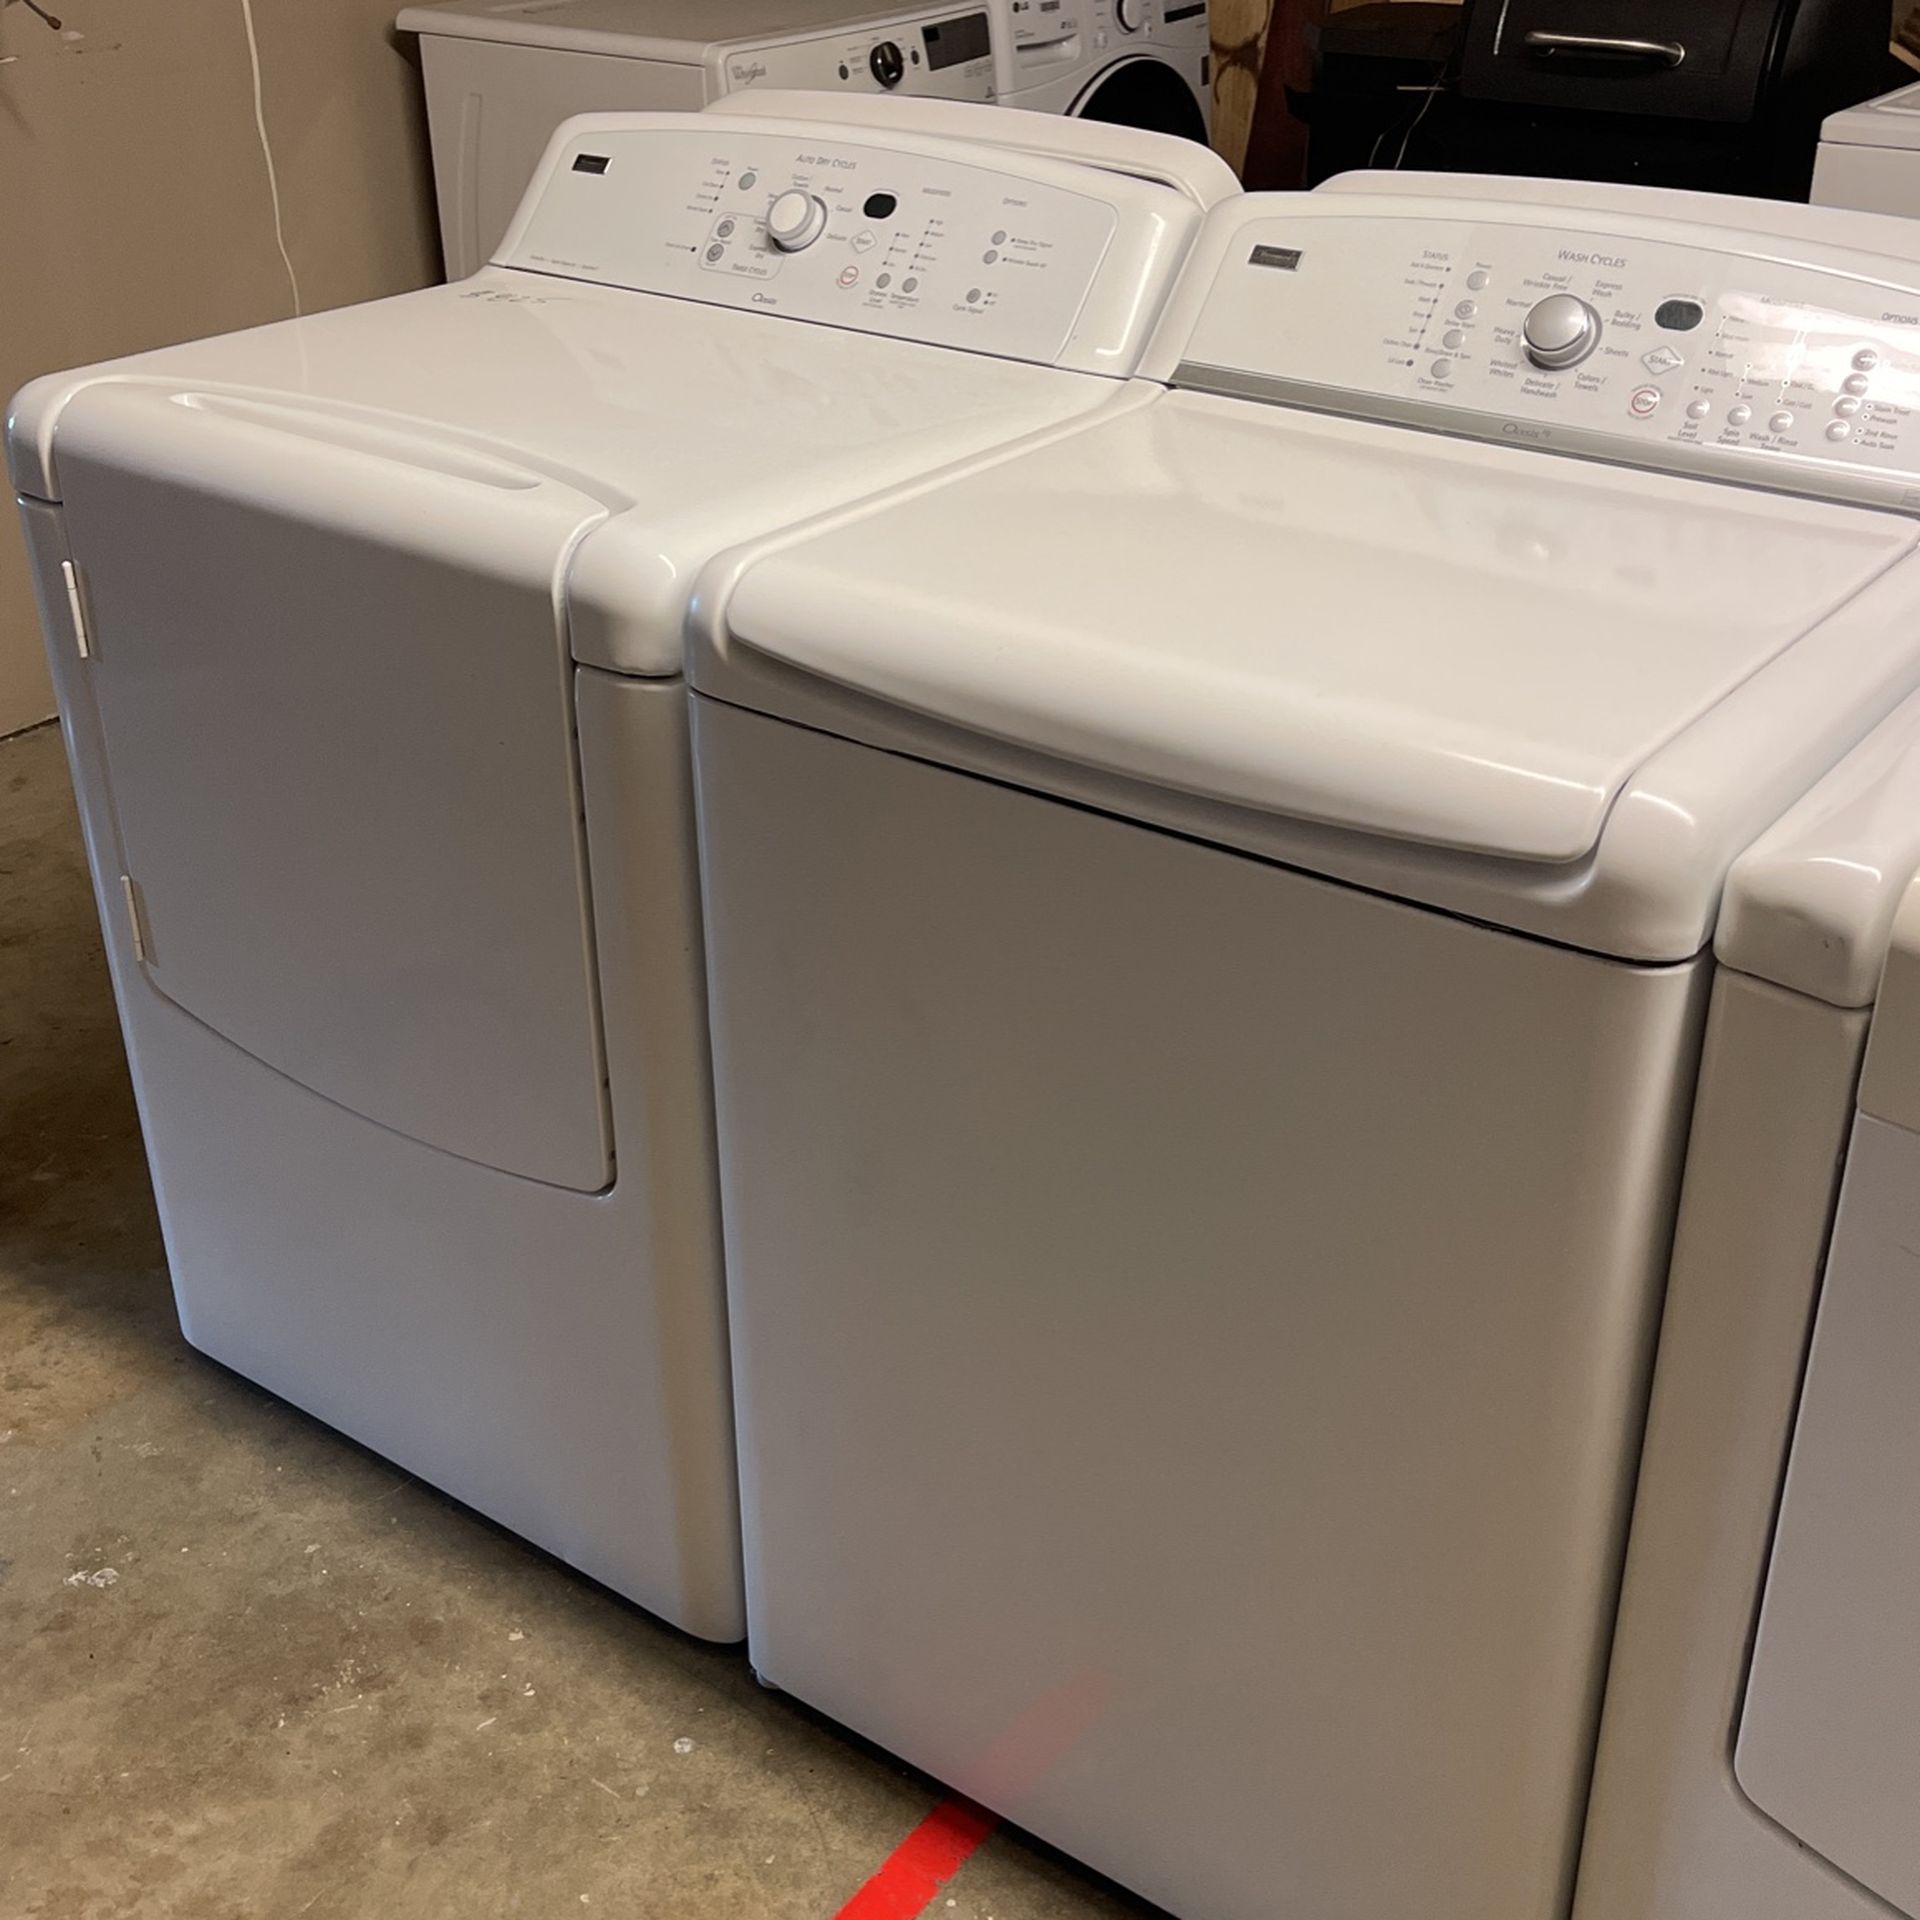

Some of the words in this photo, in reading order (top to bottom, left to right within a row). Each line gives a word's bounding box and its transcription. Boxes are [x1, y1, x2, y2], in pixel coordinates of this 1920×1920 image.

[1558, 250, 1589, 264] WASH
[1590, 254, 1627, 268] CYCLES
[1542, 272, 1567, 282] Casual
[1523, 279, 1551, 290] Wrinkle
[1552, 283, 1568, 291] Free
[1595, 280, 1622, 290] Express
[1592, 288, 1612, 298] Wash
[1506, 298, 1533, 308] Normal
[1614, 310, 1637, 321] Bulky
[1882, 312, 1918, 326] OPTIONS
[1610, 318, 1641, 332] Bedding
[1494, 327, 1515, 336] Heavy
[1494, 335, 1512, 345] Duty
[1604, 347, 1629, 358] Sheets
[1489, 368, 1514, 378] Whites
[1577, 372, 1600, 383] Colors
[1524, 378, 1554, 389] Delicate
[1575, 380, 1599, 392] Towels
[1520, 386, 1557, 398] Handwash
[1683, 420, 1699, 430] Soil
[1678, 429, 1698, 439] Level
[1723, 428, 1740, 438] Spin
[1716, 436, 1740, 446] Speed
[1749, 432, 1770, 442] Wash
[1778, 436, 1798, 447] Rinse
